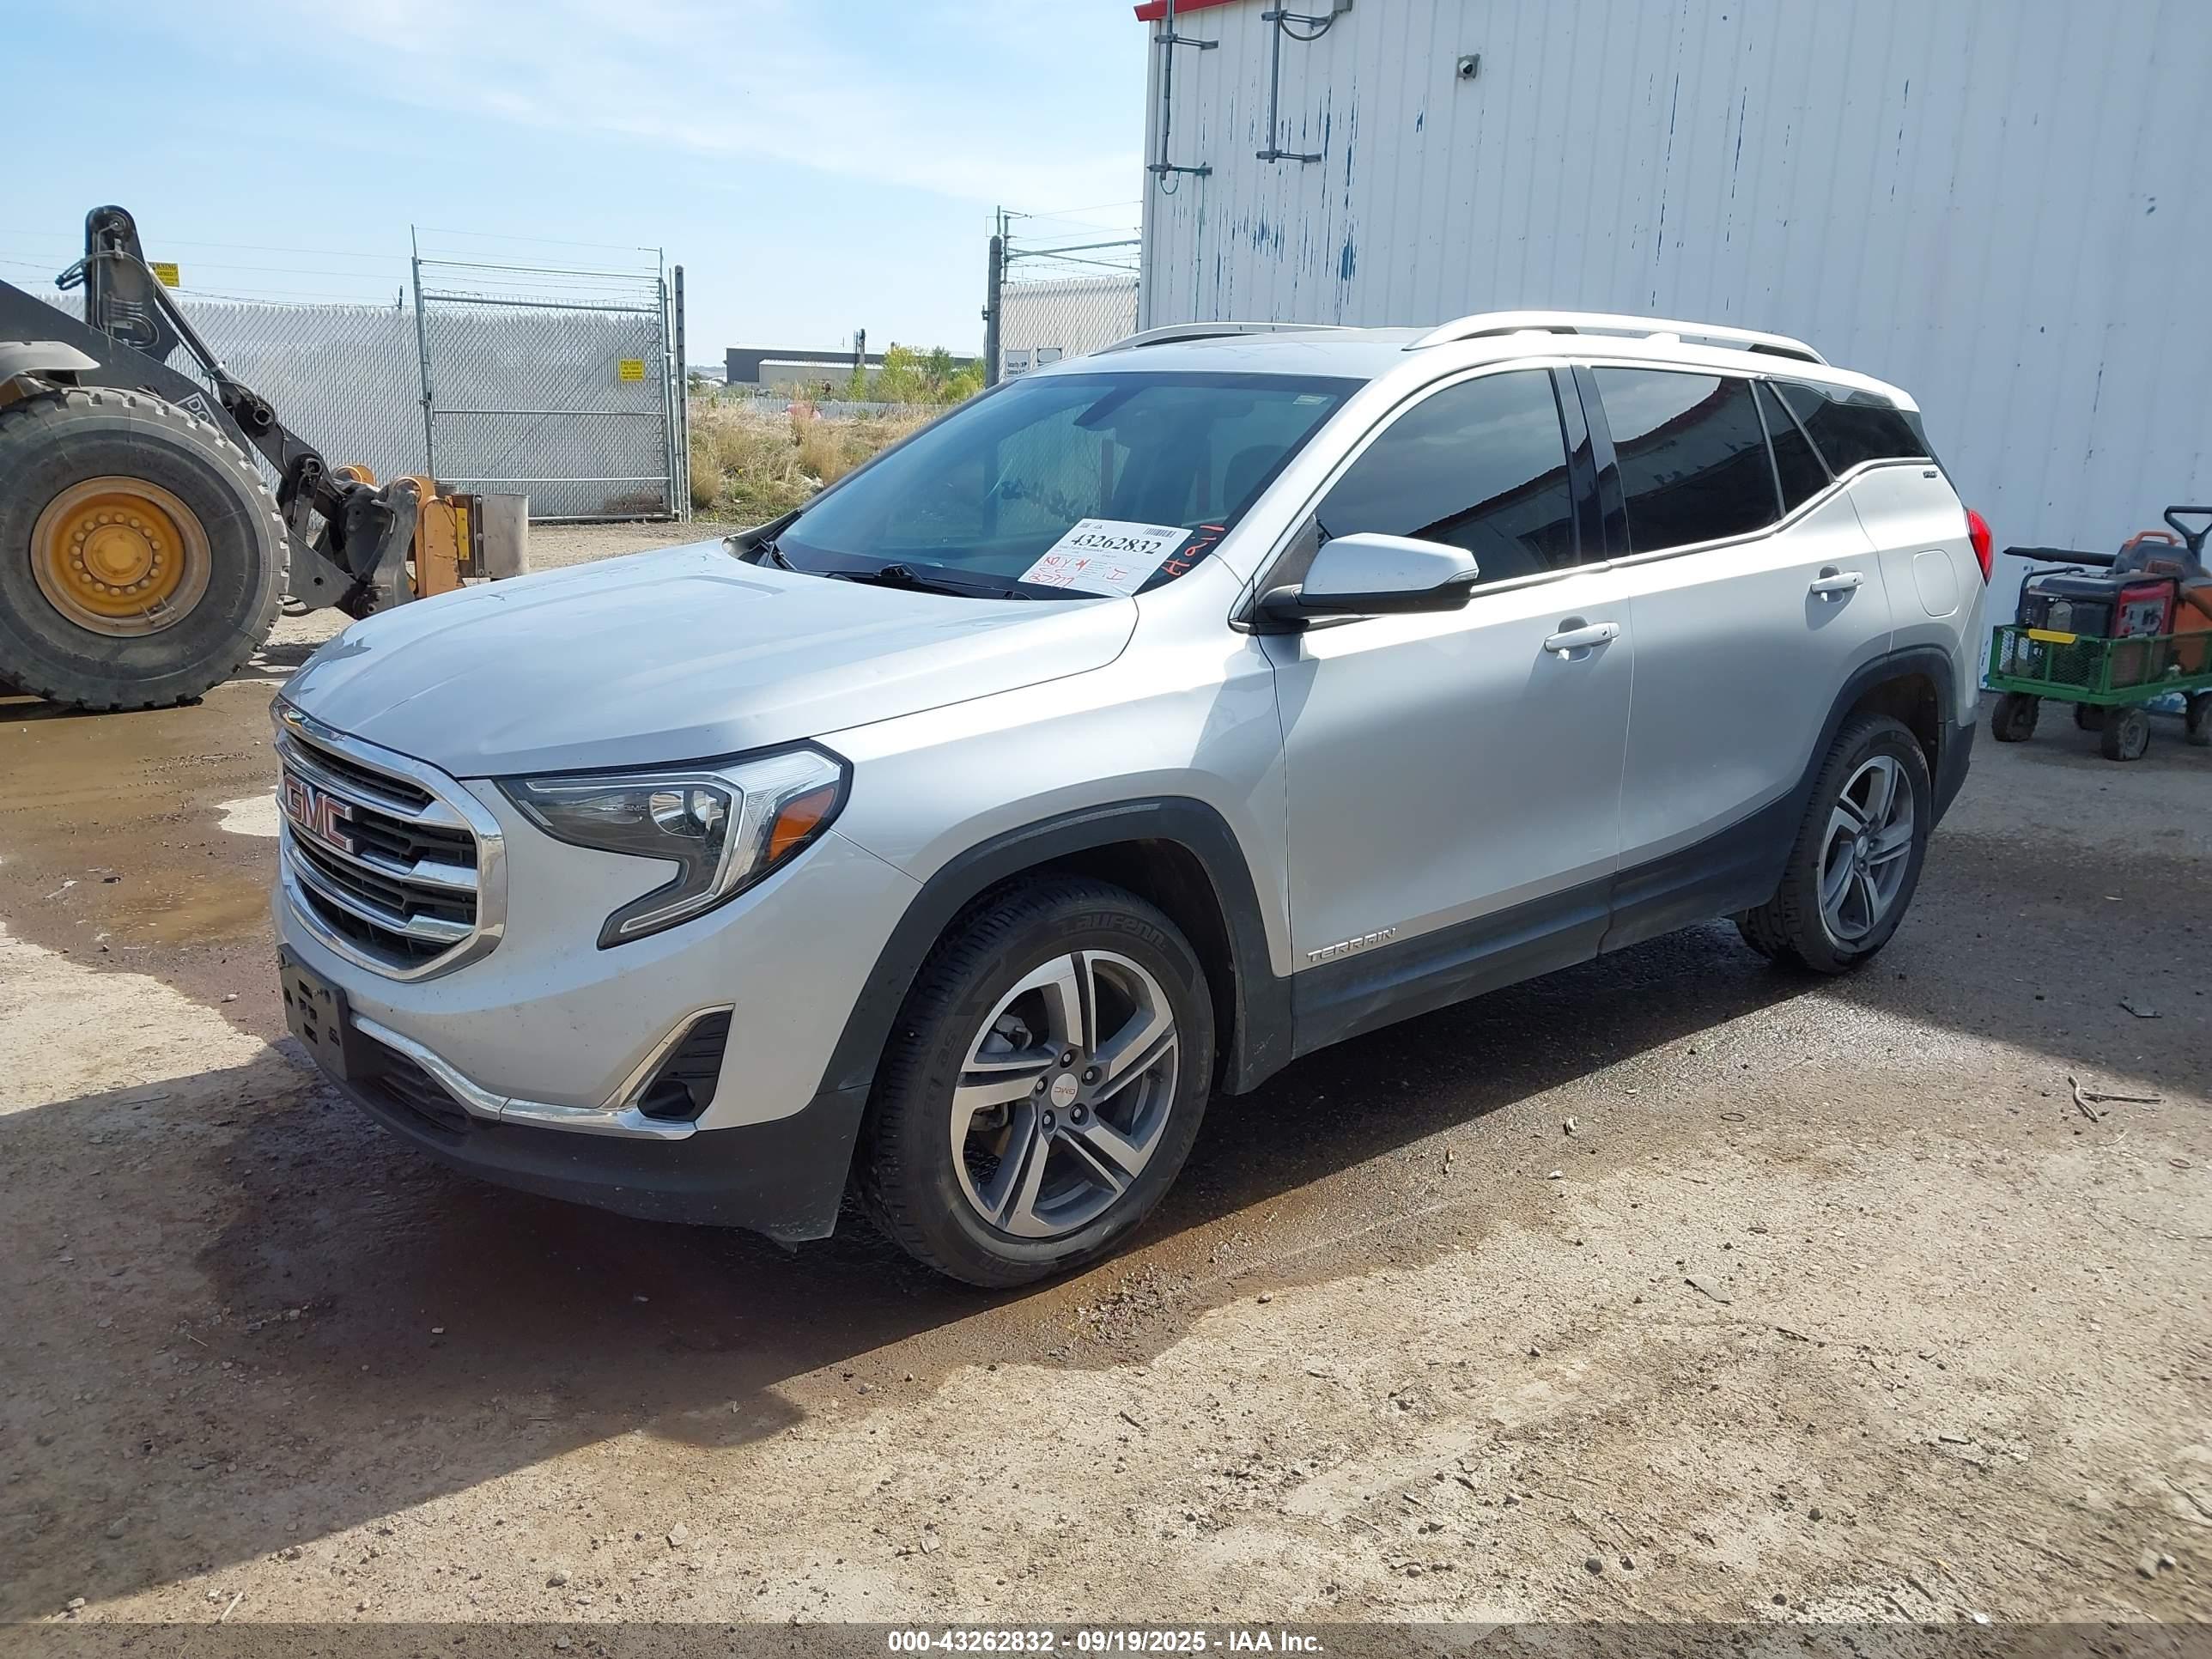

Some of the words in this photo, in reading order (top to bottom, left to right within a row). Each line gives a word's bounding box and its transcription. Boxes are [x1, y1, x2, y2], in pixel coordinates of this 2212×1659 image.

[1071, 532, 1162, 556] 43262832
[283, 772, 354, 854] GMC
[1305, 927, 1396, 963] TERRAIN
[1054, 1086, 1076, 1095] GMC
